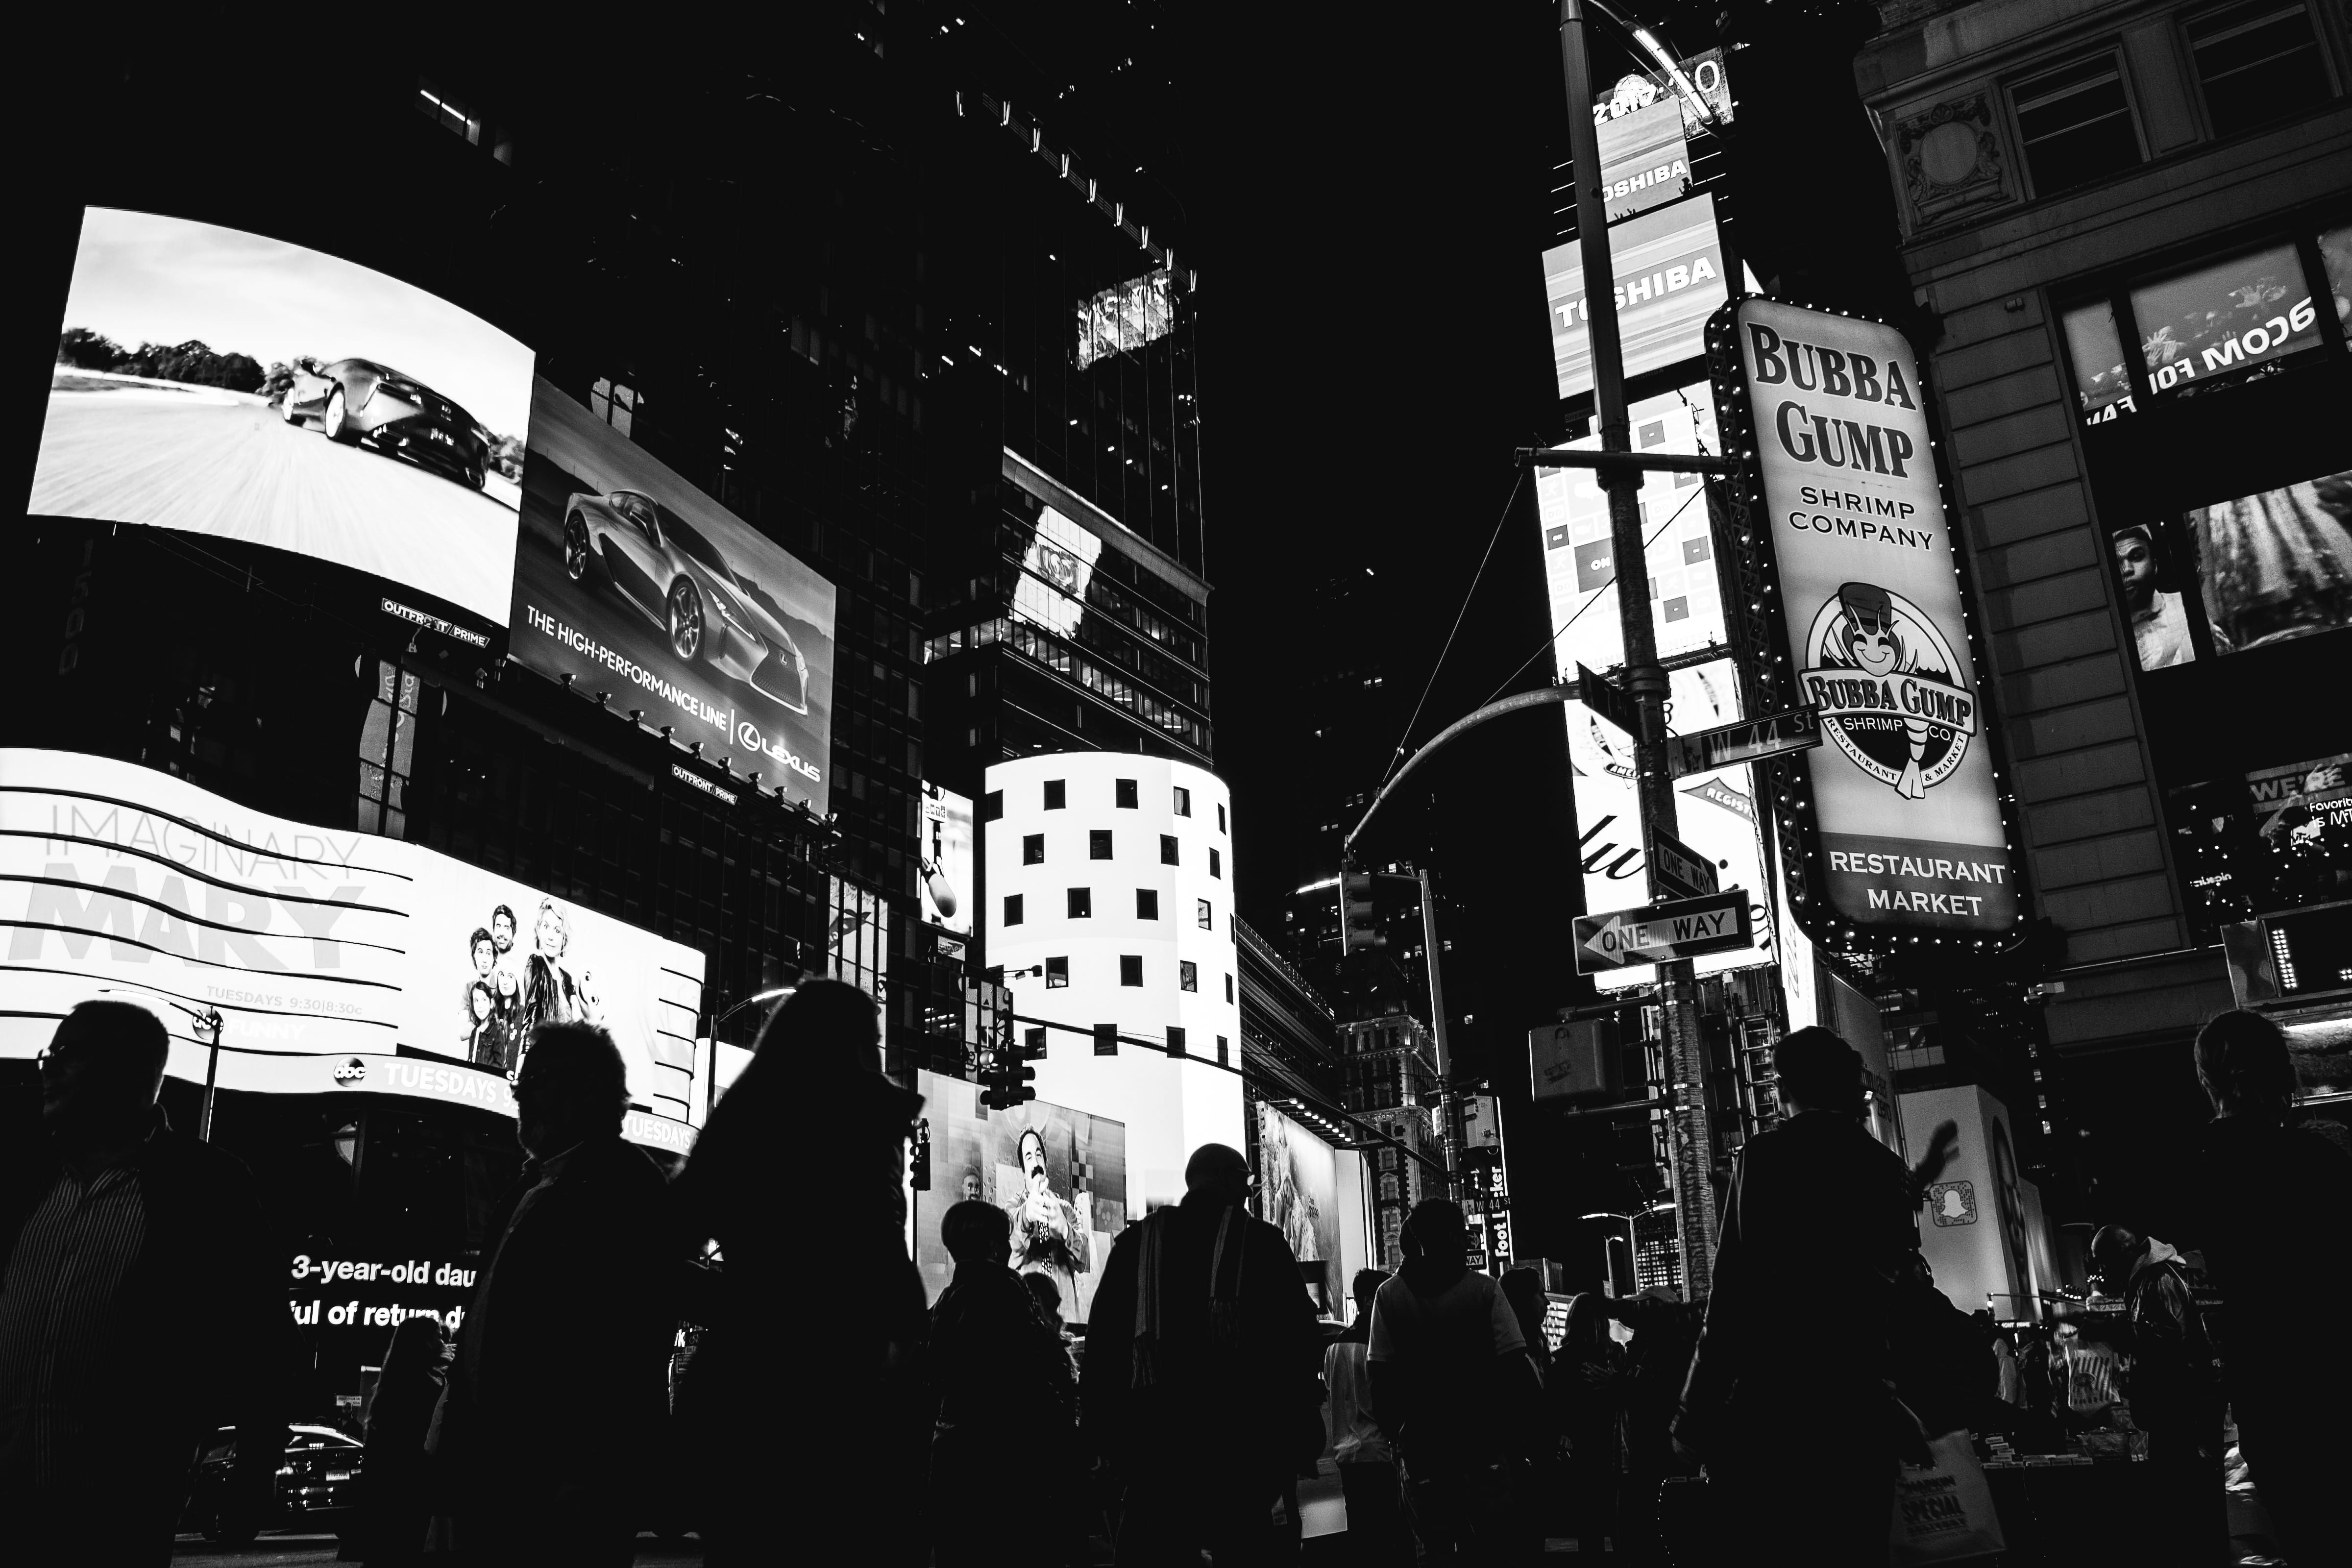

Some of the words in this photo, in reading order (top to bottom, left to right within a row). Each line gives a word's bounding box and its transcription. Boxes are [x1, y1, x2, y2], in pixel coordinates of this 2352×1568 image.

[1603, 160, 1688, 203] OSHIBA
[1747, 322, 1916, 411] BUBBA
[1776, 400, 1913, 479] GUMP
[1800, 487, 1915, 520] SHRIMP
[1789, 512, 1933, 550] COMPANY
[1590, 556, 1611, 571] ON
[454, 627, 486, 647] PRIME
[527, 605, 555, 637] THE
[558, 621, 698, 716] HIGH-PERFORMANCE
[700, 701, 727, 732] LINE
[1807, 675, 1898, 712] BUBBA
[1901, 678, 1972, 727] GUMP
[1709, 731, 1731, 762] W
[1747, 720, 1782, 753] 44
[1794, 712, 1814, 733] St
[1844, 717, 1903, 732] SHRIMP
[1929, 726, 1952, 742] CO.
[761, 737, 821, 783] LEXUS
[1828, 718, 1897, 781] RESTAURANT
[1924, 773, 1932, 782] &
[1934, 735, 1964, 781] MARKET
[673, 765, 713, 793] OUTFRONT
[714, 787, 736, 804] PRIME
[46, 804, 363, 880] IMAGINARY
[1663, 848, 1684, 880] ONE
[1692, 865, 1711, 895] WAY
[1830, 851, 2005, 884] RESTAURANT
[8, 863, 366, 971] MARY
[1867, 889, 1982, 916] MARKET
[1601, 925, 1650, 952] ONE
[1673, 912, 1725, 941] WAY
[207, 985, 283, 1007] TUESDAYS
[228, 1018, 306, 1040] FUNNY
[334, 1063, 367, 1078] abc
[384, 1062, 496, 1104] TUESDAYS
[623, 1115, 691, 1150] TUESDAYS
[1476, 1200, 1485, 1212] W
[1489, 1199, 1500, 1210] 44
[1503, 1197, 1511, 1205] St
[1490, 1166, 1506, 1218] Lker
[1494, 1222, 1509, 1257] Foot
[292, 1255, 430, 1284] 3-year-old
[328, 1301, 359, 1325] of
